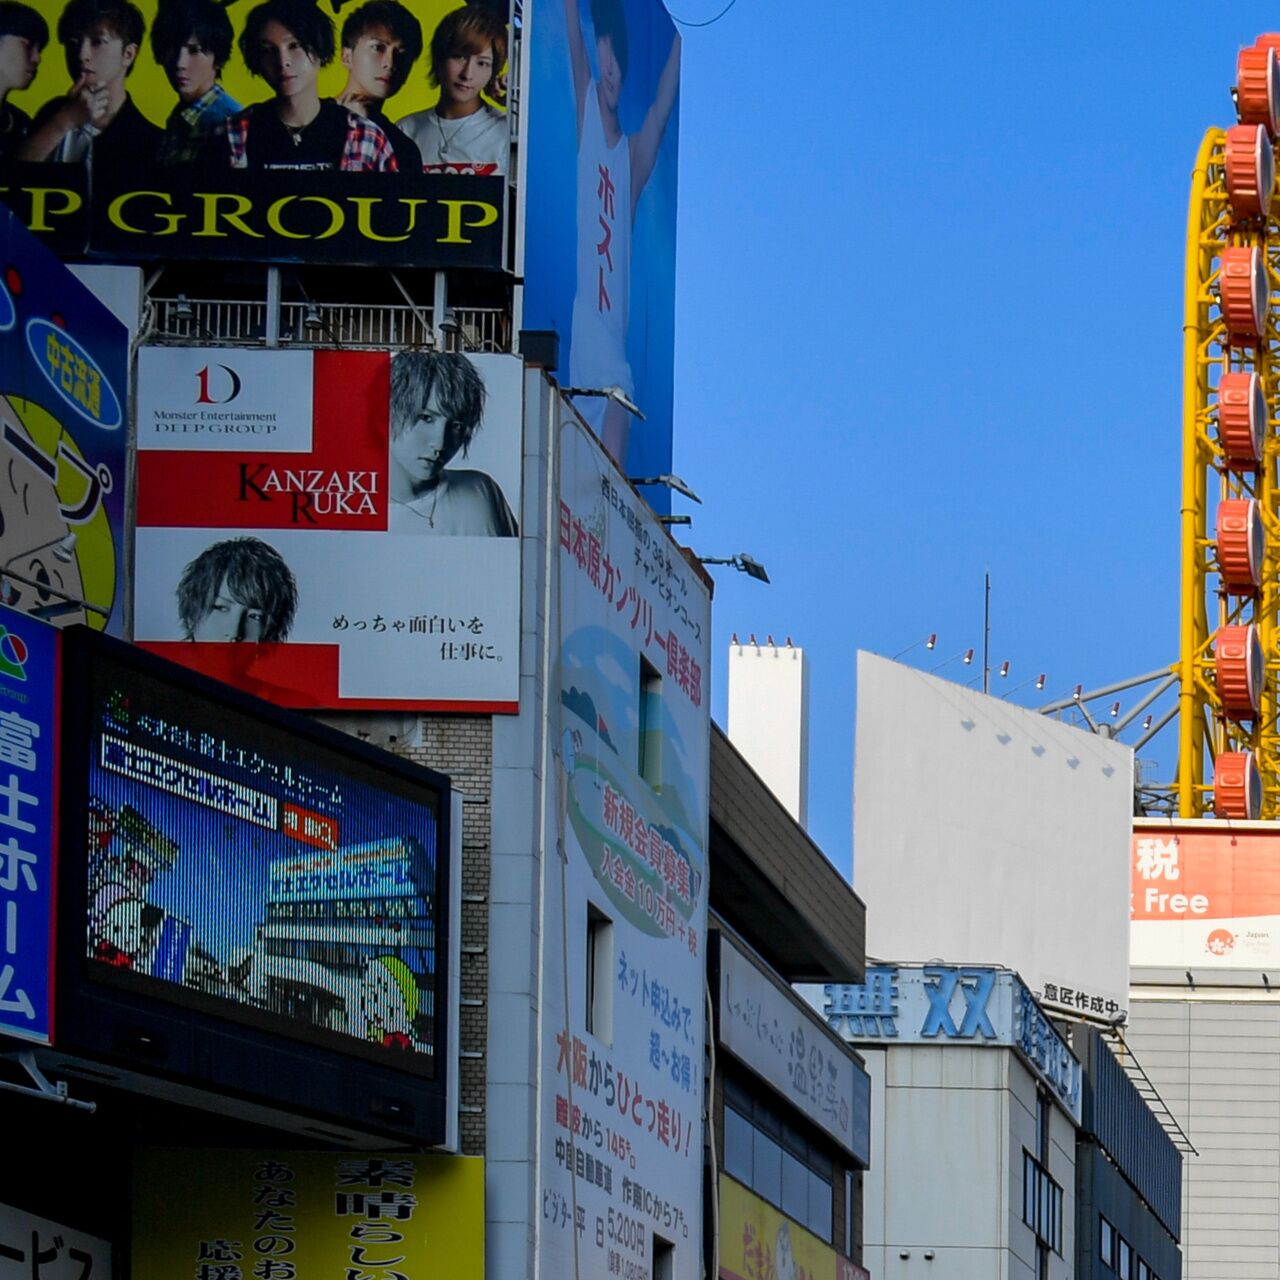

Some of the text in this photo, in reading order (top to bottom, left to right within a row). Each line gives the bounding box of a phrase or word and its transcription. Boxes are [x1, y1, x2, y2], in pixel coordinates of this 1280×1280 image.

[107, 190, 499, 243] GROUP
[154, 410, 276, 423] Monster Entertainment
[155, 423, 277, 434] DEEP GROUP
[239, 463, 378, 501] KANZAKI
[291, 491, 378, 524] RUKA
[561, 500, 702, 706] 日本原カンツリー倶楽部
[332, 615, 485, 635] めっちゃ面白いを
[440, 642, 503, 663] 仕事に。
[1137, 838, 1180, 881] 税
[1145, 888, 1209, 913] Free
[1043, 982, 1120, 1016] 意匠作成中
[557, 1031, 693, 1157] 大阪からひとつ走り!
[555, 1139, 613, 1197] 中国自動車道
[607, 1208, 646, 1259] 5,200円
